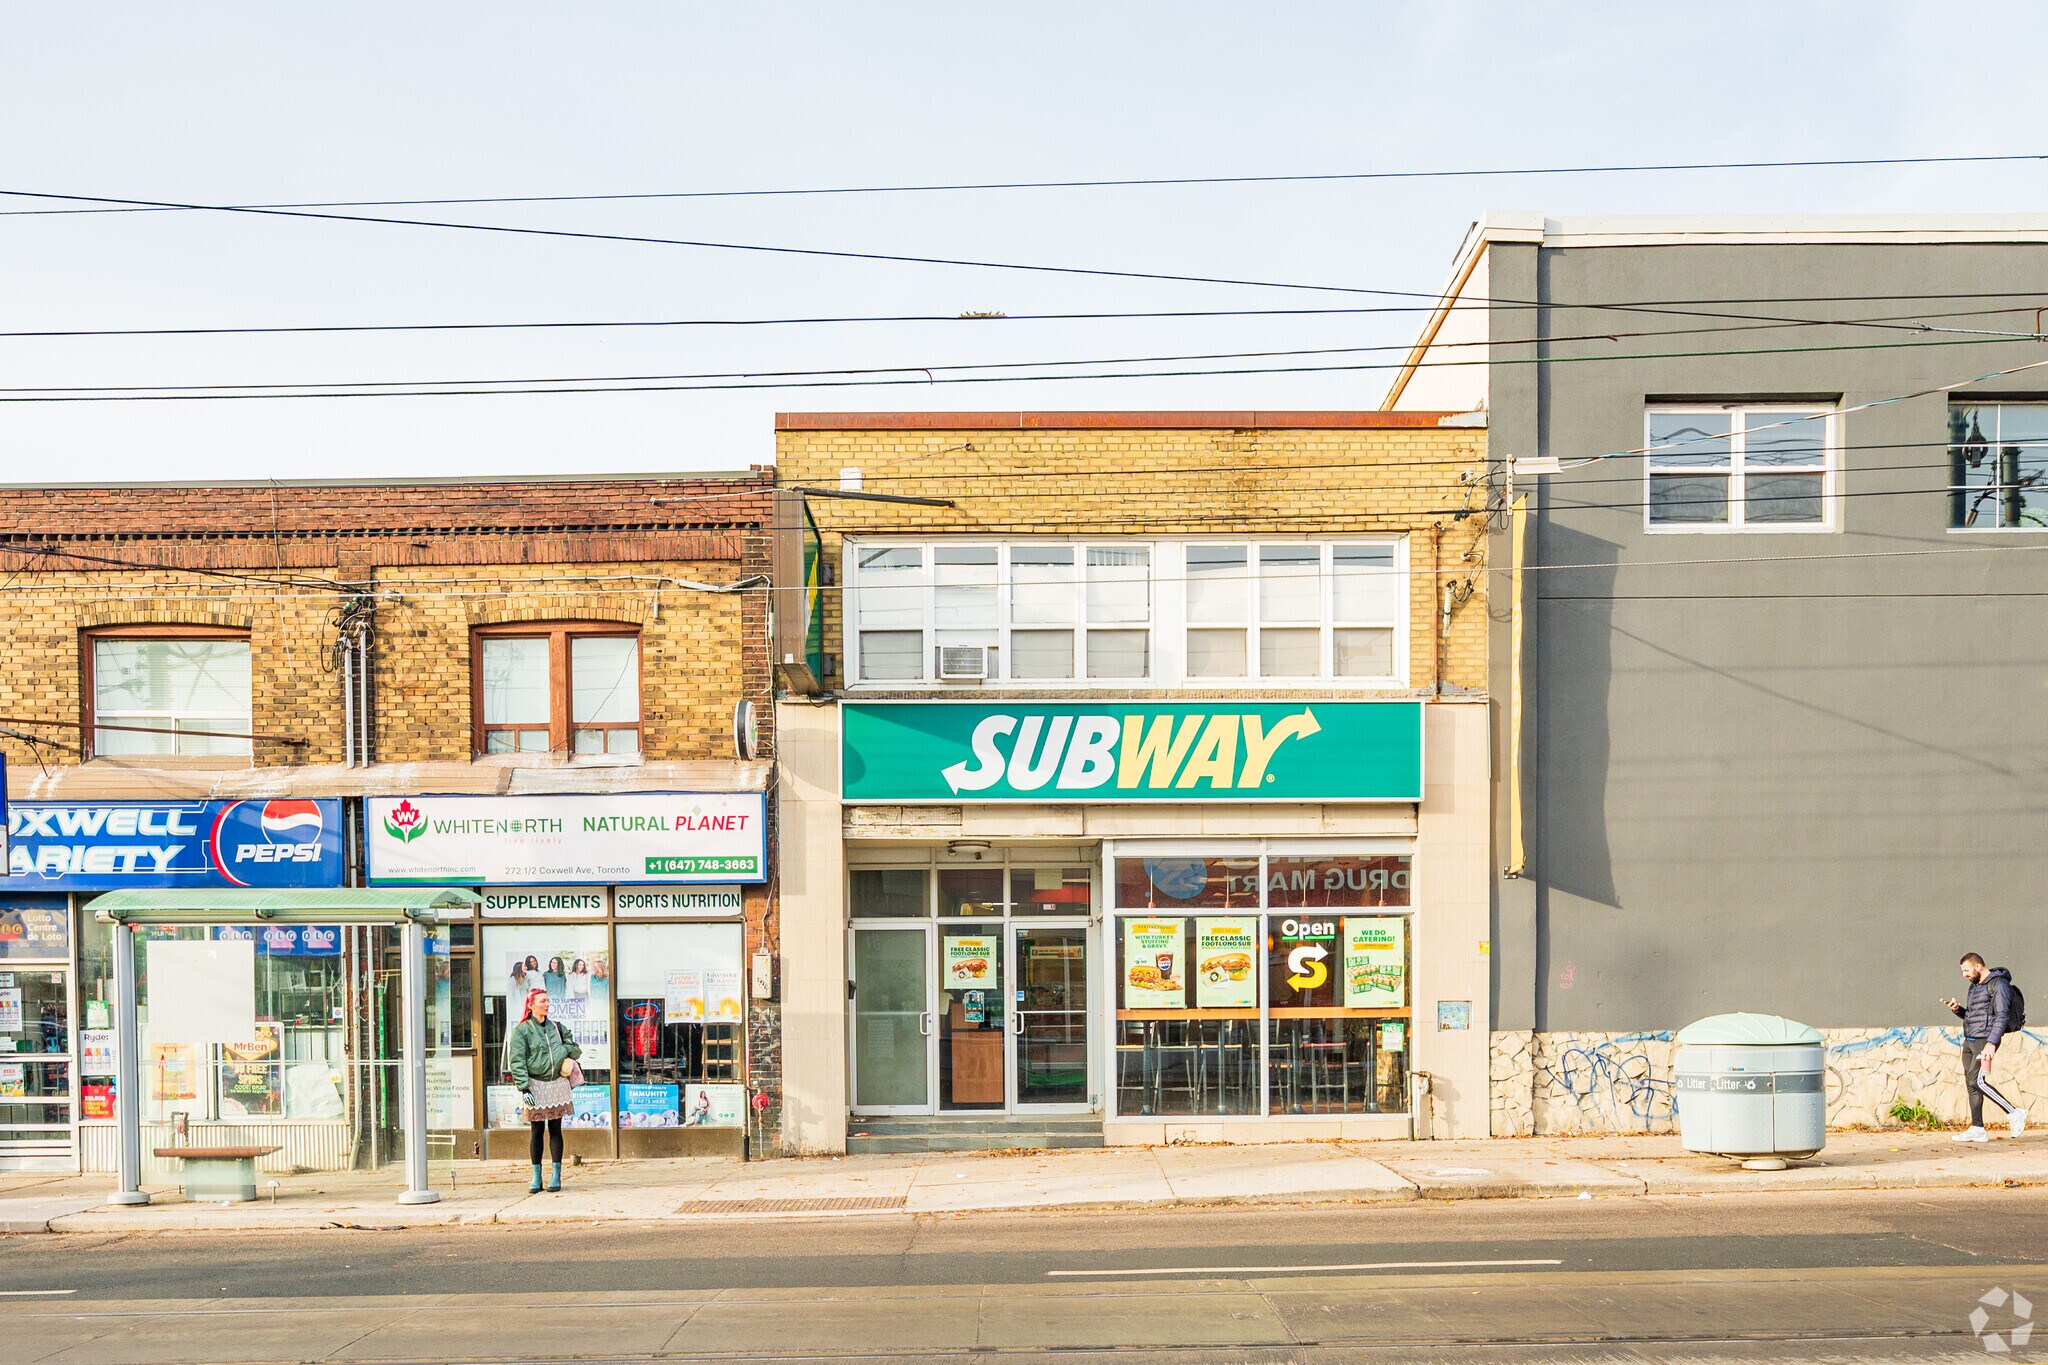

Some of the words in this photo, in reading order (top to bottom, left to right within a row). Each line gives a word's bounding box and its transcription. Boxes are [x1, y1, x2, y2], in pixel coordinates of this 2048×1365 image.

[941, 706, 1321, 796] SUBWAY
[583, 816, 670, 832] NATURAL
[675, 815, 749, 831] PLANET
[531, 837, 562, 845] lively
[235, 843, 322, 863] PEPSI
[388, 865, 476, 874] www.whitenorthinc.com
[505, 867, 521, 875] 272
[524, 867, 536, 875] 1/2
[539, 866, 574, 875] Coxwell
[576, 866, 594, 876] Ave,
[597, 865, 630, 874] Toronto
[649, 860, 662, 871] +1
[664, 859, 695, 872] (647)
[698, 859, 754, 871] 748-3663
[486, 895, 600, 910] SUPPLEMENTS
[618, 894, 668, 909] SPORTS
[672, 893, 740, 908] NUTRITION
[27, 914, 51, 922] Lotto
[27, 923, 57, 932] Centre
[1281, 919, 1335, 940] Open
[27, 933, 38, 941] de
[42, 933, 62, 941] Loto
[234, 1042, 267, 1051] MrBen
[1686, 1077, 1707, 1090] Litter
[1715, 1078, 1741, 1091] Litter
